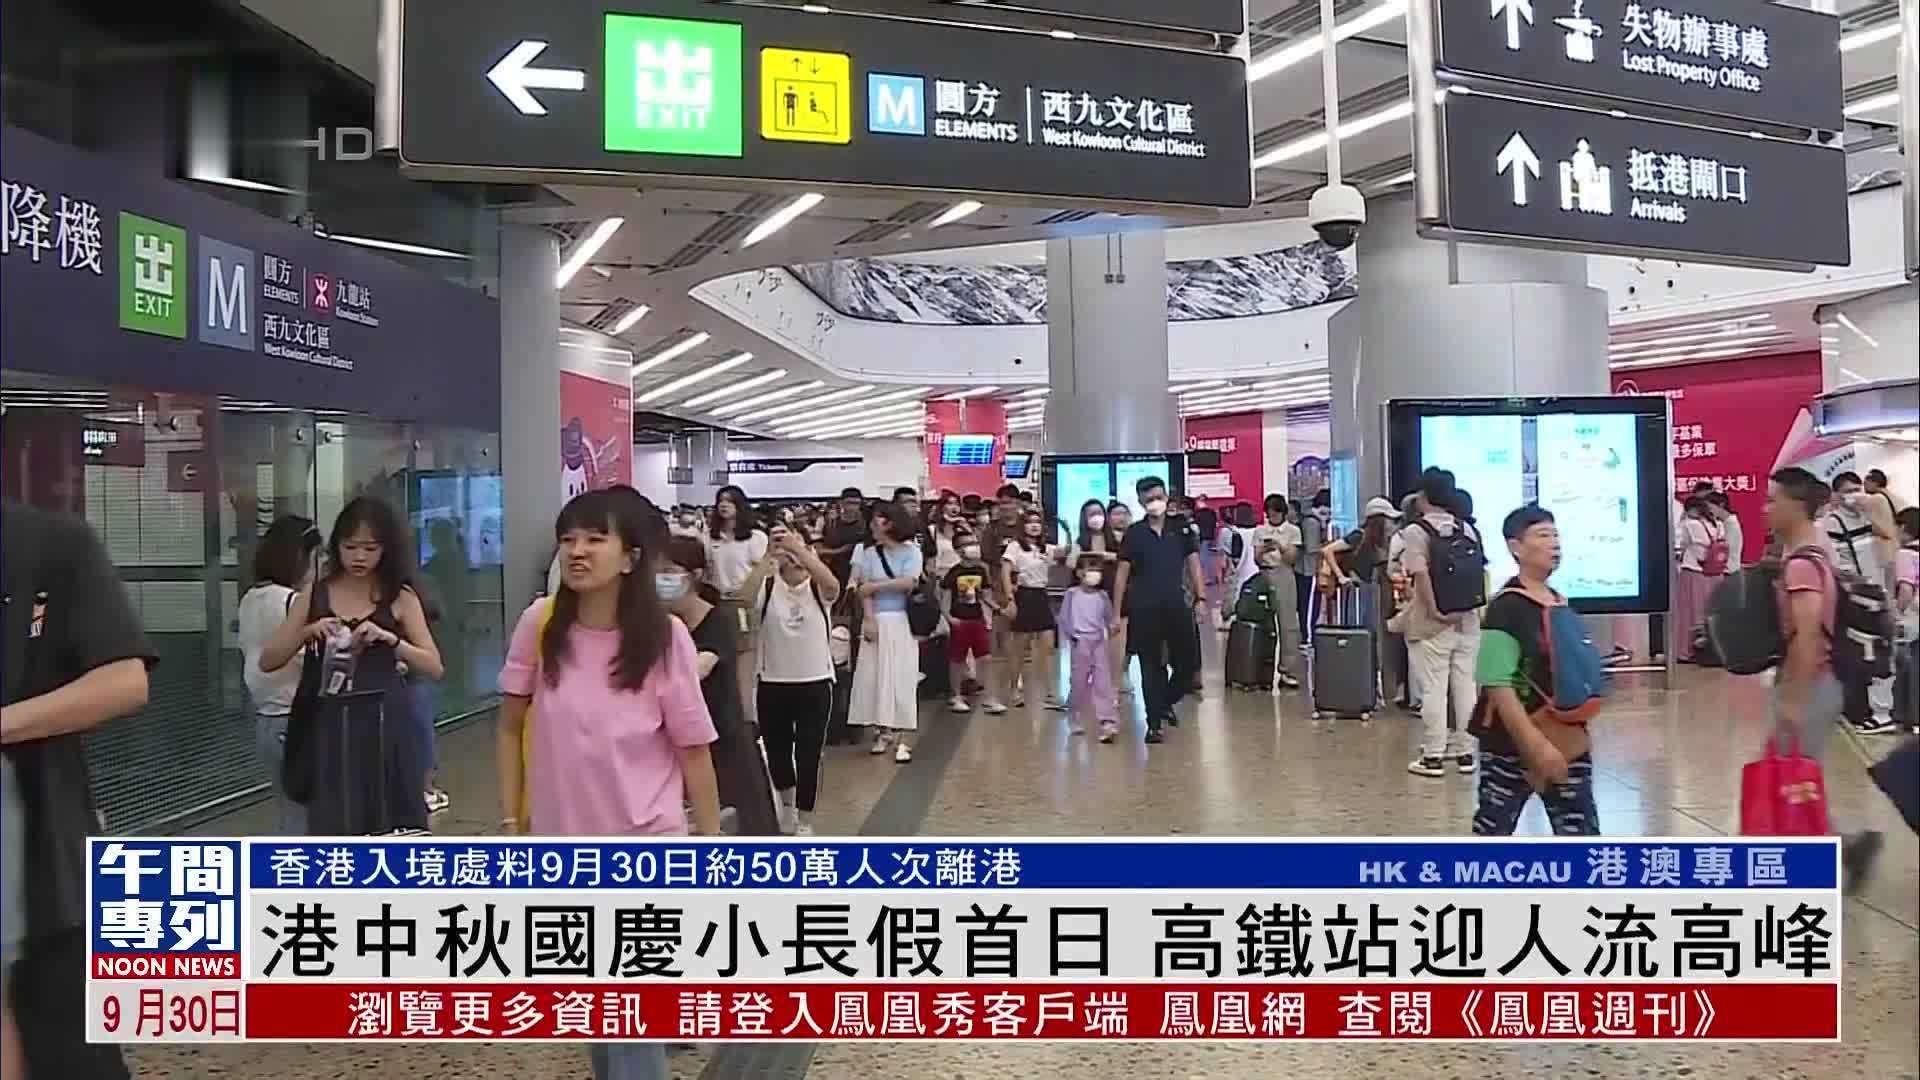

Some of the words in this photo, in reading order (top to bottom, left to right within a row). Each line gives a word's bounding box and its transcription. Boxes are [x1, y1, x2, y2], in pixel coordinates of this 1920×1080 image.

[1622, 3, 1769, 68] 失物辦事處
[636, 40, 712, 105] 出
[1623, 49, 1655, 71] Lost
[1656, 55, 1717, 88] Property
[1720, 66, 1761, 92] Office
[636, 105, 710, 129] EXIT
[935, 79, 1000, 117] 圓方
[1042, 91, 1193, 134] 西九文化區
[934, 118, 1018, 142] ELEMENTS
[1042, 128, 1072, 146] West
[1073, 130, 1122, 150] Kowloon
[1123, 134, 1166, 153] Cultural
[1167, 139, 1206, 157] District
[1628, 149, 1747, 203] 抵港閘口
[1, 180, 102, 274] 降機
[1630, 198, 1687, 223] Arrivals
[135, 234, 173, 296] 出
[134, 292, 173, 318] EXIT
[208, 257, 247, 334] M
[263, 313, 330, 350] 西九文化區
